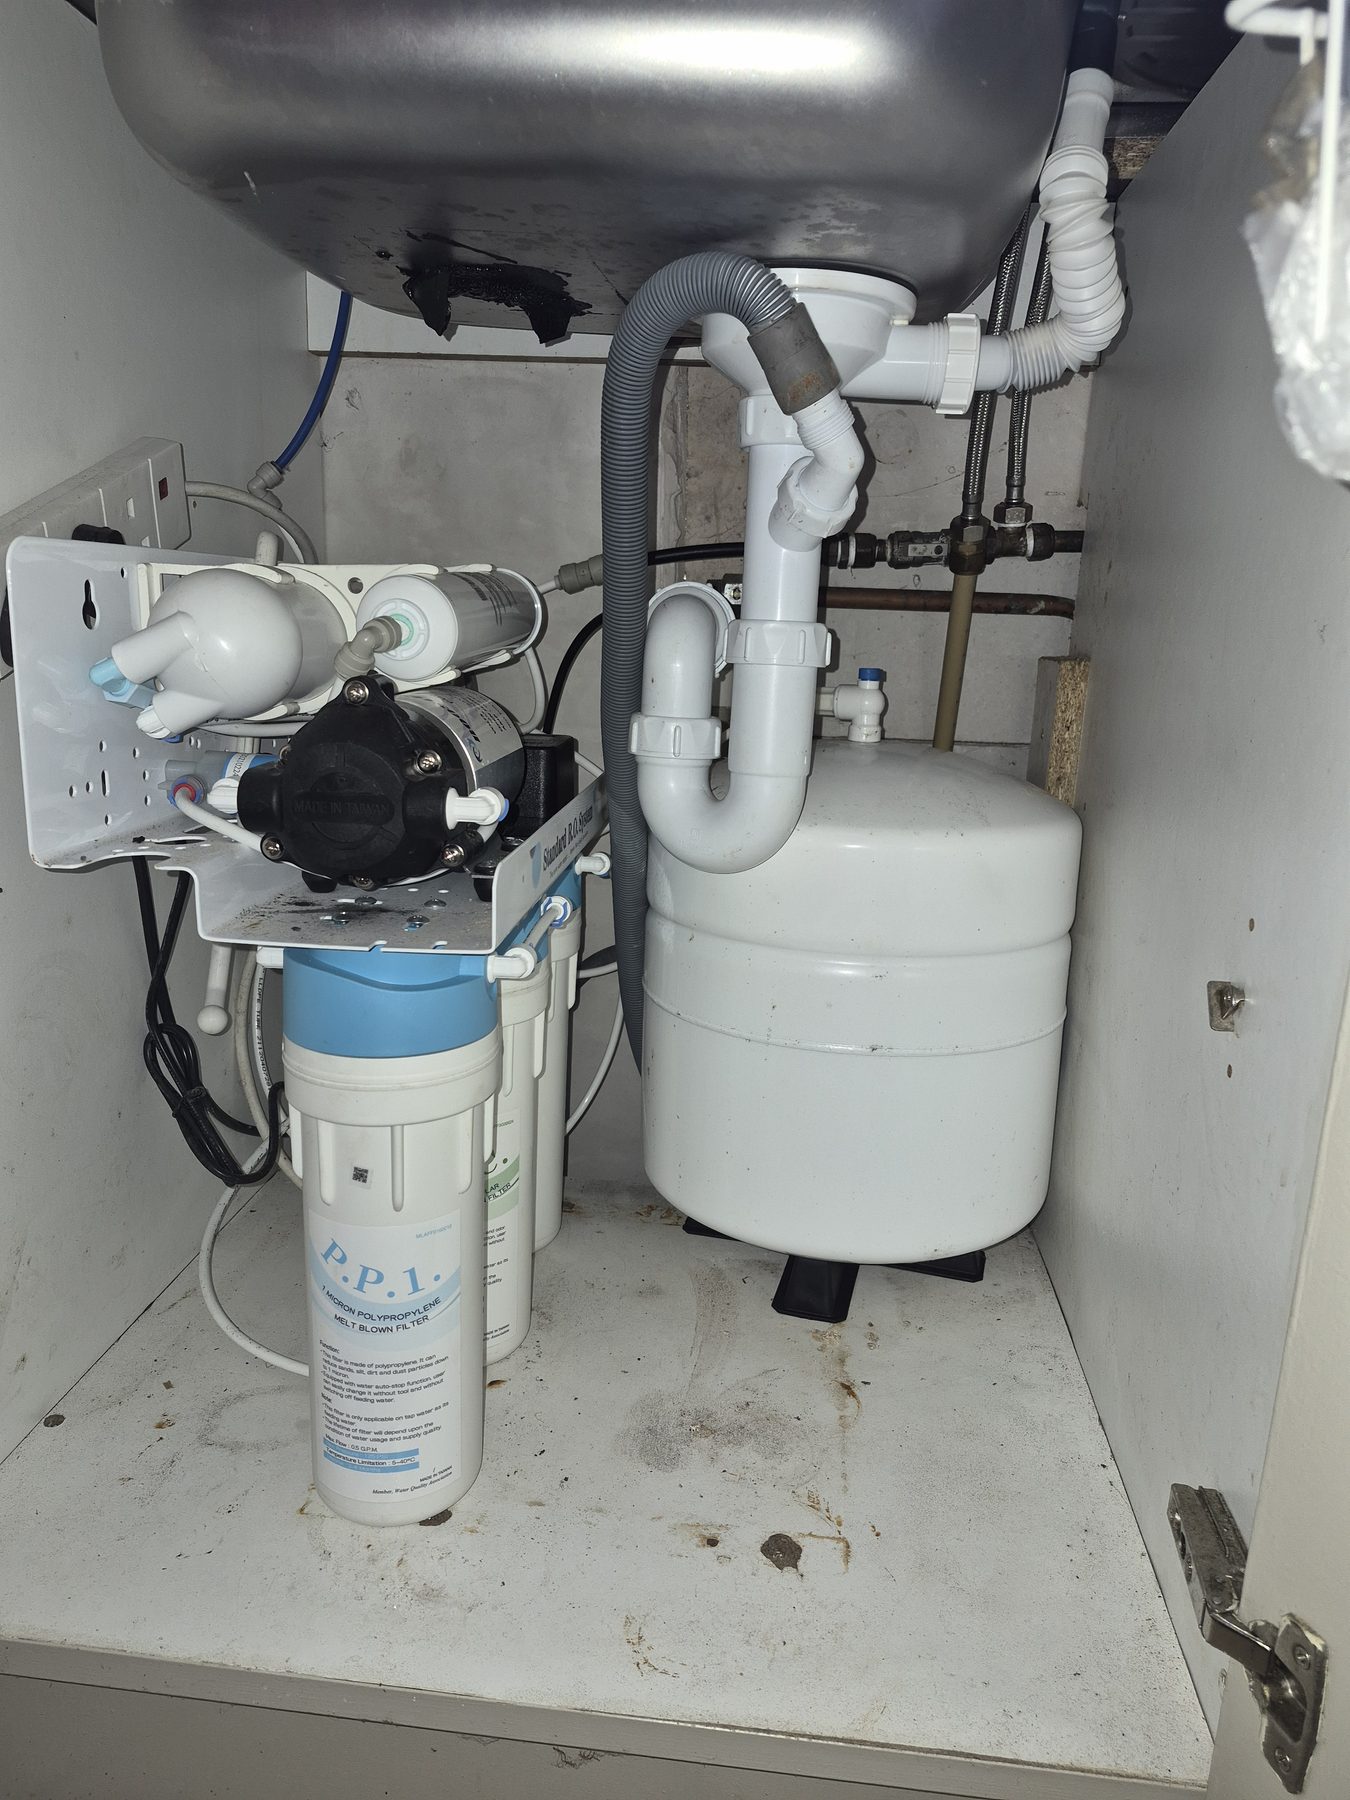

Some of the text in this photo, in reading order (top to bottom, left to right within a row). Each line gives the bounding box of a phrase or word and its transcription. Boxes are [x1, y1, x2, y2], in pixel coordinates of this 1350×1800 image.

[330, 800, 343, 816] IN
[543, 828, 567, 871] Standard
[579, 806, 593, 833] System
[487, 1182, 511, 1200] FILTER
[326, 1290, 356, 1315] MICRON
[357, 1296, 442, 1322] POLYPROPYLENE
[334, 1314, 430, 1334] MELT BLOWN FILTER
[408, 1362, 434, 1373] particles
[434, 1356, 449, 1365] down
[346, 1388, 366, 1396] change
[423, 1378, 444, 1390] without
[353, 1396, 375, 1404] feeding
[416, 1408, 434, 1417] water
[384, 1428, 407, 1436] depend
[408, 1425, 423, 1433] upon
[402, 1432, 422, 1441] supply
[336, 1438, 347, 1447] Flow
[326, 1447, 357, 1463] Temperature
[410, 1482, 428, 1492] Quality
